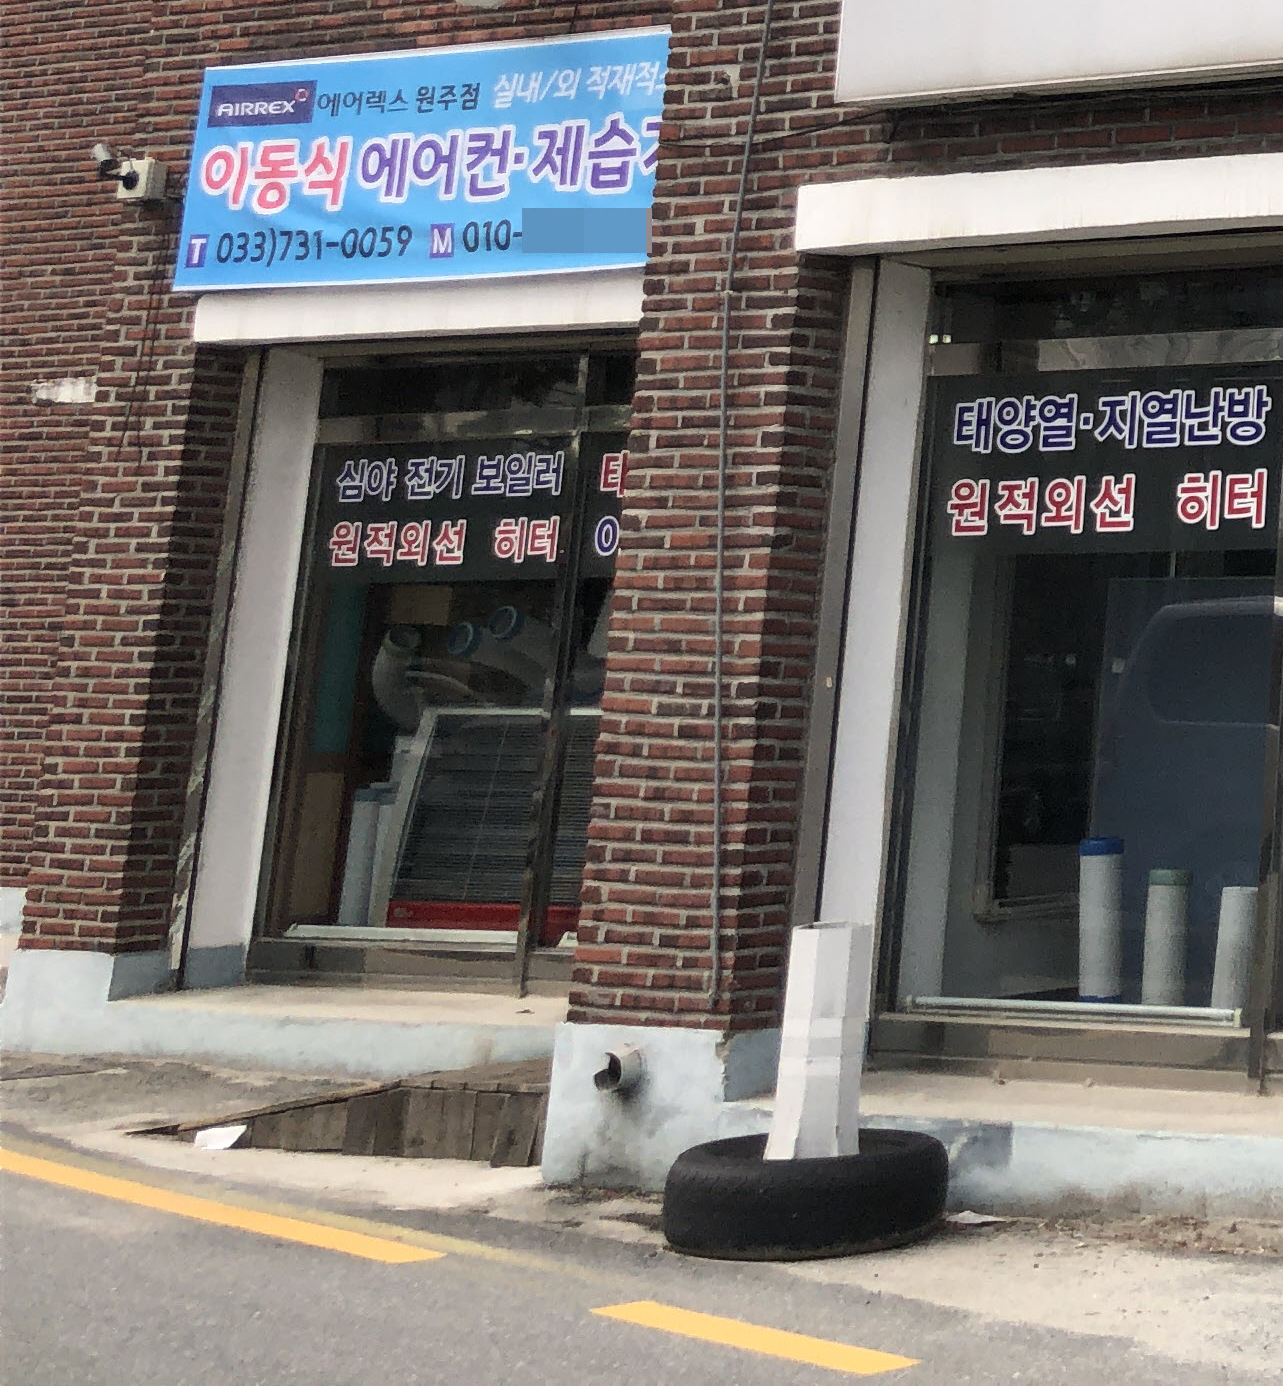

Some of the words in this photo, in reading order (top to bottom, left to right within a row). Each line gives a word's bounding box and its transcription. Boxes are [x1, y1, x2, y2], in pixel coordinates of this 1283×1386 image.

[217, 99, 296, 117] AIRREX
[317, 87, 410, 118] 에어렉스
[416, 83, 480, 114] 원주점
[586, 61, 667, 101] 적재적
[203, 135, 352, 213] 이동식
[189, 237, 207, 267] T
[217, 224, 414, 267] 033)731-0059
[432, 228, 453, 255] M
[336, 457, 398, 502] 심야
[405, 454, 465, 500] 전기
[471, 451, 565, 496] 보일러
[947, 473, 1136, 537] 원적외선
[1177, 468, 1269, 529] 히터
[329, 519, 468, 567] 원적외선
[494, 516, 561, 563] 히터
